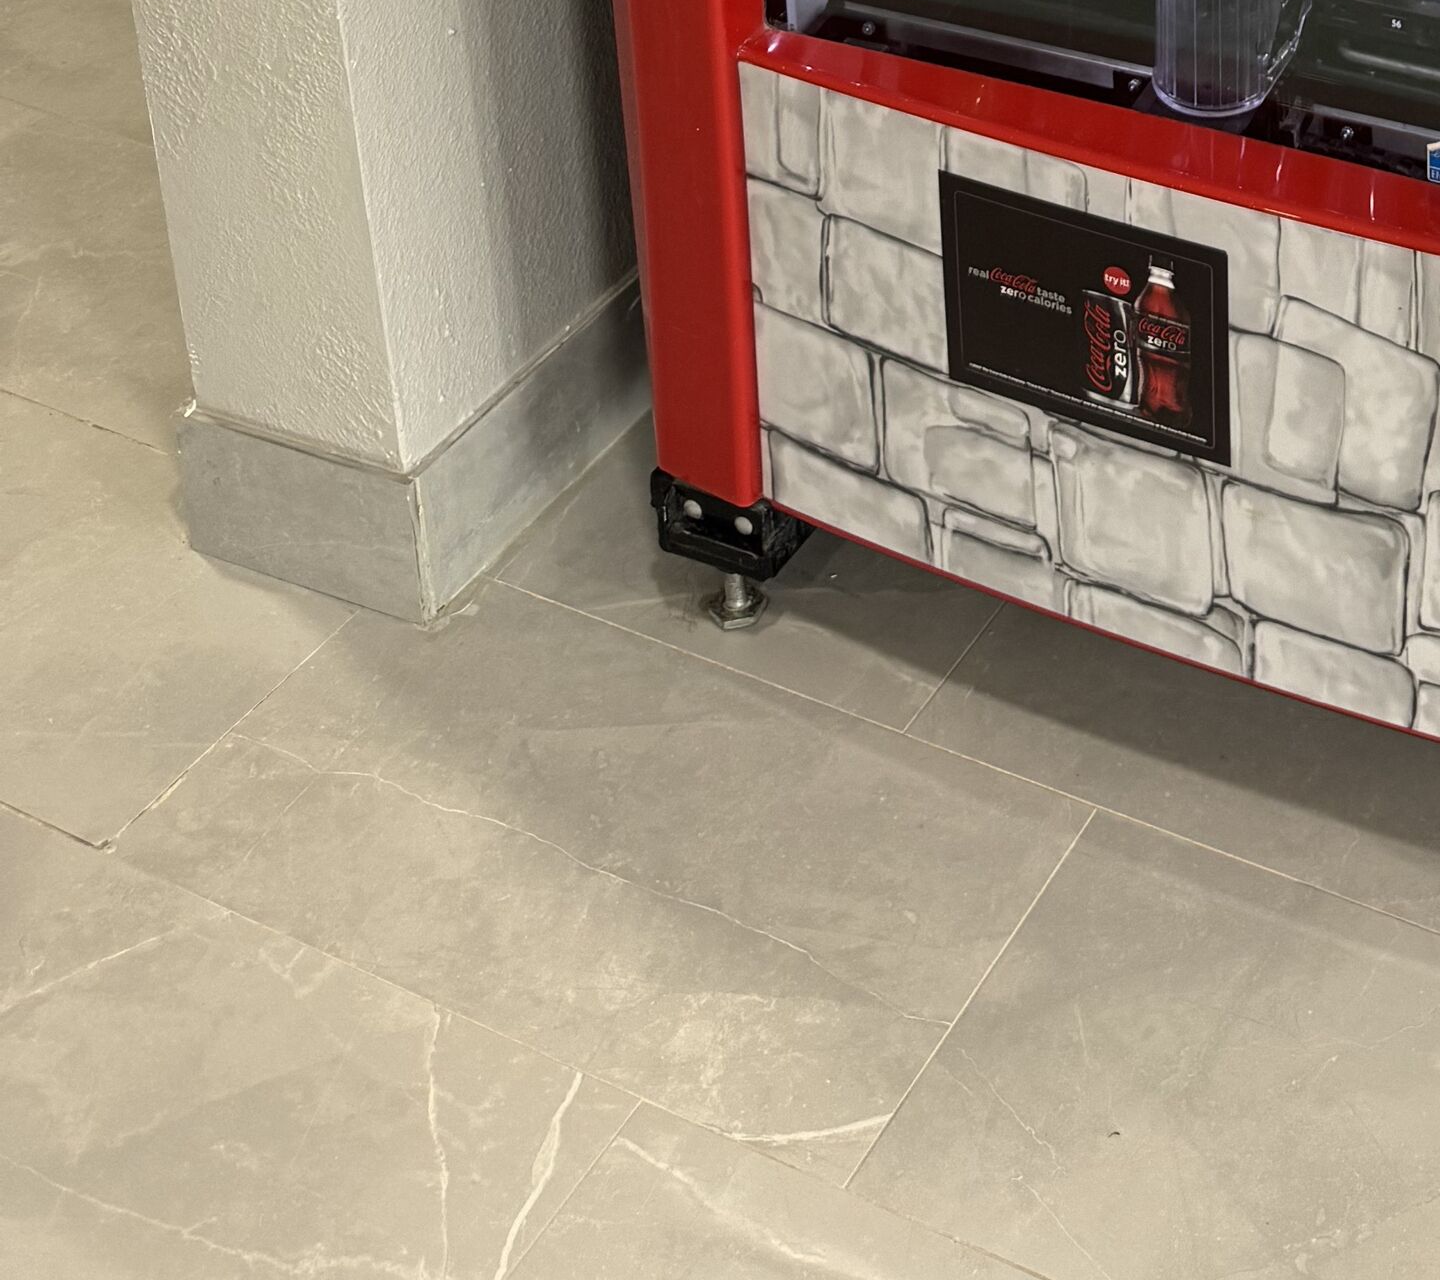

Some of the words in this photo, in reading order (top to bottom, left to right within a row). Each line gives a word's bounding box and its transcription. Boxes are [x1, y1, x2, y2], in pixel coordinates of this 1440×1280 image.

[1391, 18, 1402, 29] 56
[968, 266, 989, 280] real
[990, 267, 1038, 293] Coca-Cola
[1036, 286, 1066, 303] taste
[1103, 273, 1119, 286] try
[1000, 285, 1027, 300] zero
[1027, 293, 1073, 315] calories
[1113, 329, 1127, 379] zero
[1147, 335, 1177, 352] zero
